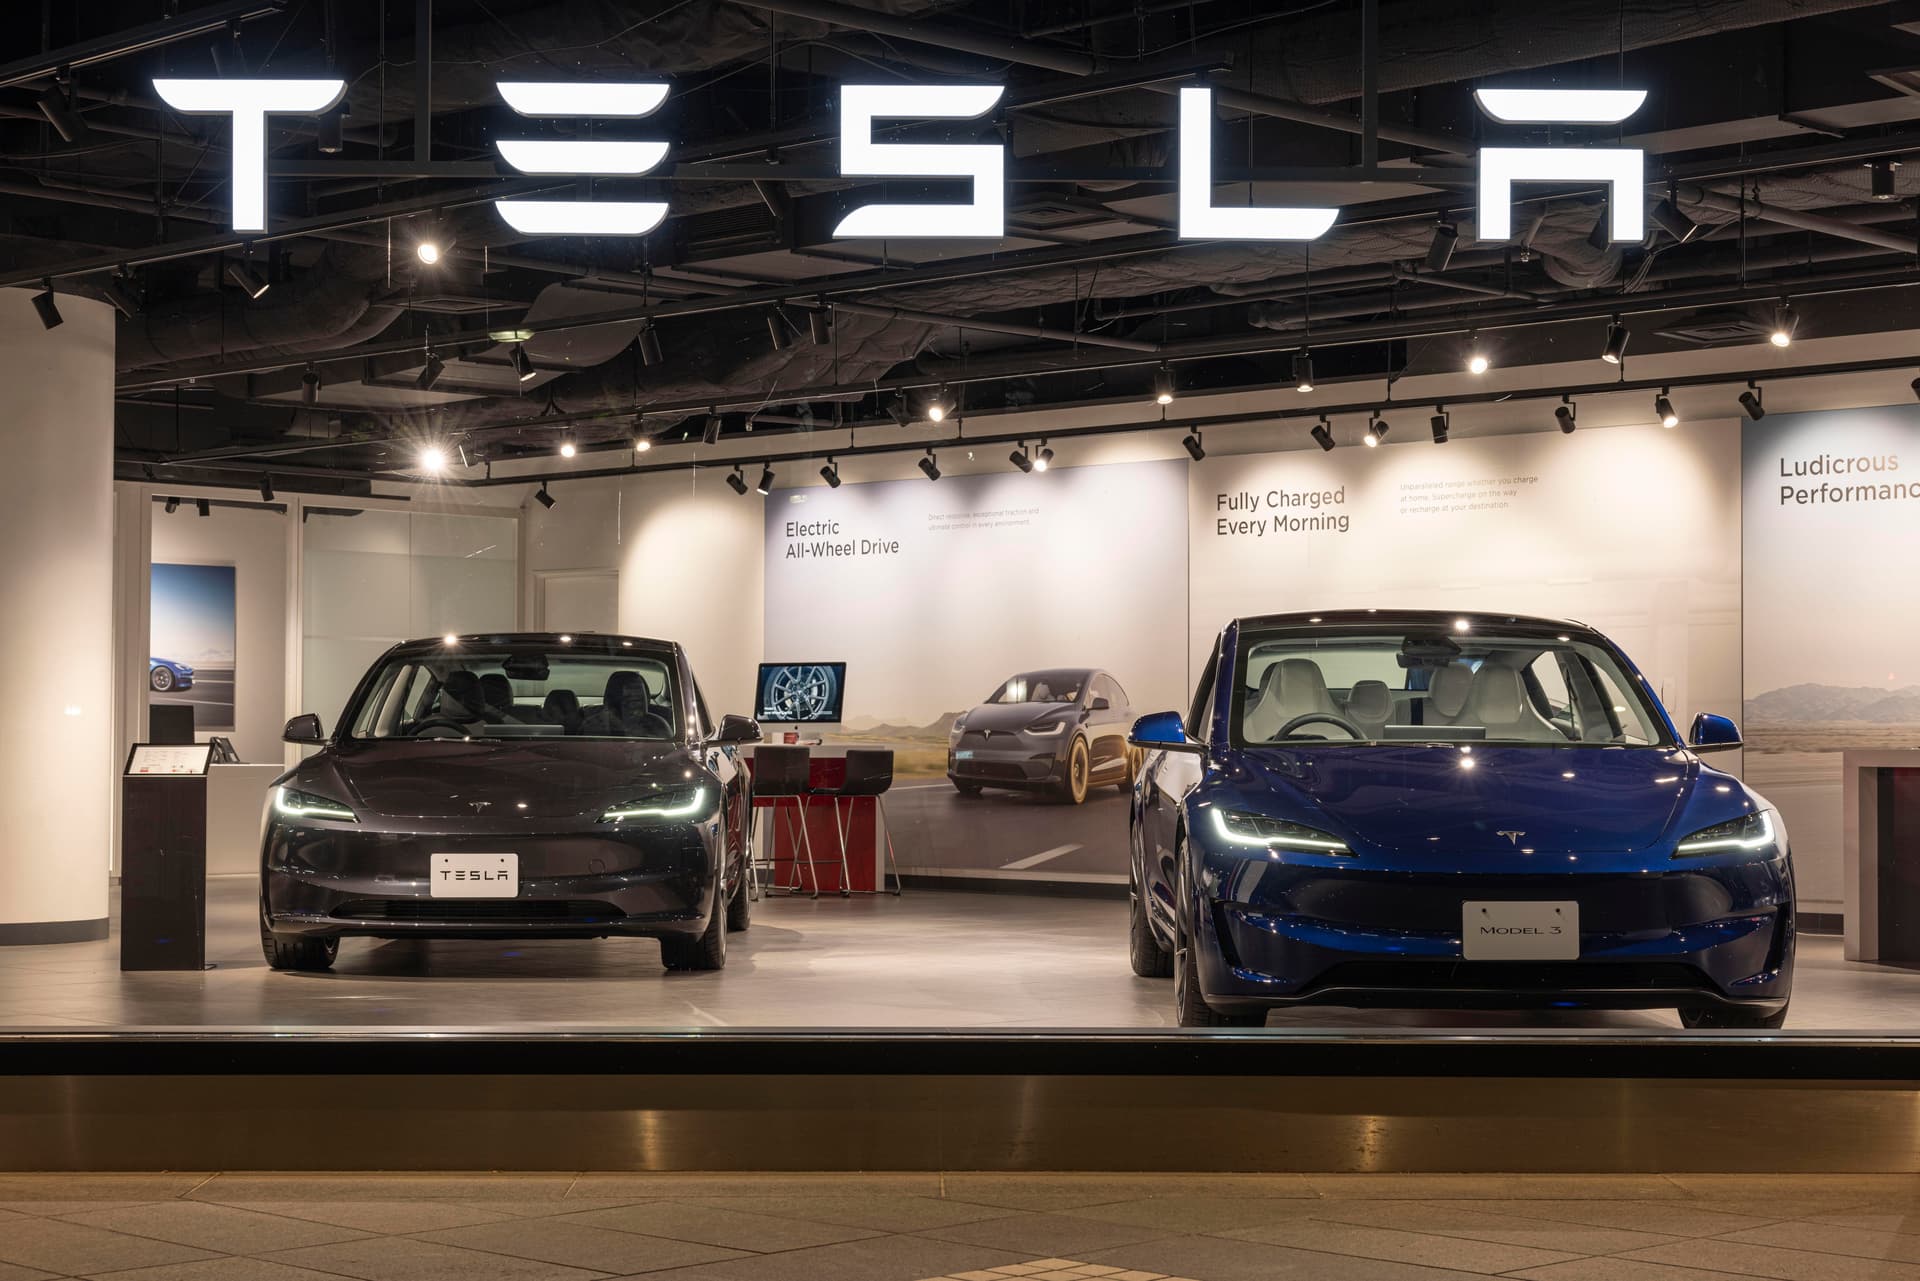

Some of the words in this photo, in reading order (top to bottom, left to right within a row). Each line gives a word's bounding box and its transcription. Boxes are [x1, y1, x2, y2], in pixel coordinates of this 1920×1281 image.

[153, 77, 1649, 244] TESLA
[1780, 454, 1899, 477] Ludicrous
[1217, 491, 1260, 513] Fully
[1266, 485, 1345, 509] Charged
[1780, 482, 1920, 505] Performanc
[786, 519, 840, 537] Electric
[1217, 518, 1267, 537] Every
[1274, 512, 1349, 533] Morning
[786, 539, 856, 559] All-Wheel
[861, 538, 900, 555] Drive
[439, 870, 508, 881] TESLA
[1549, 926, 1562, 935] 3
